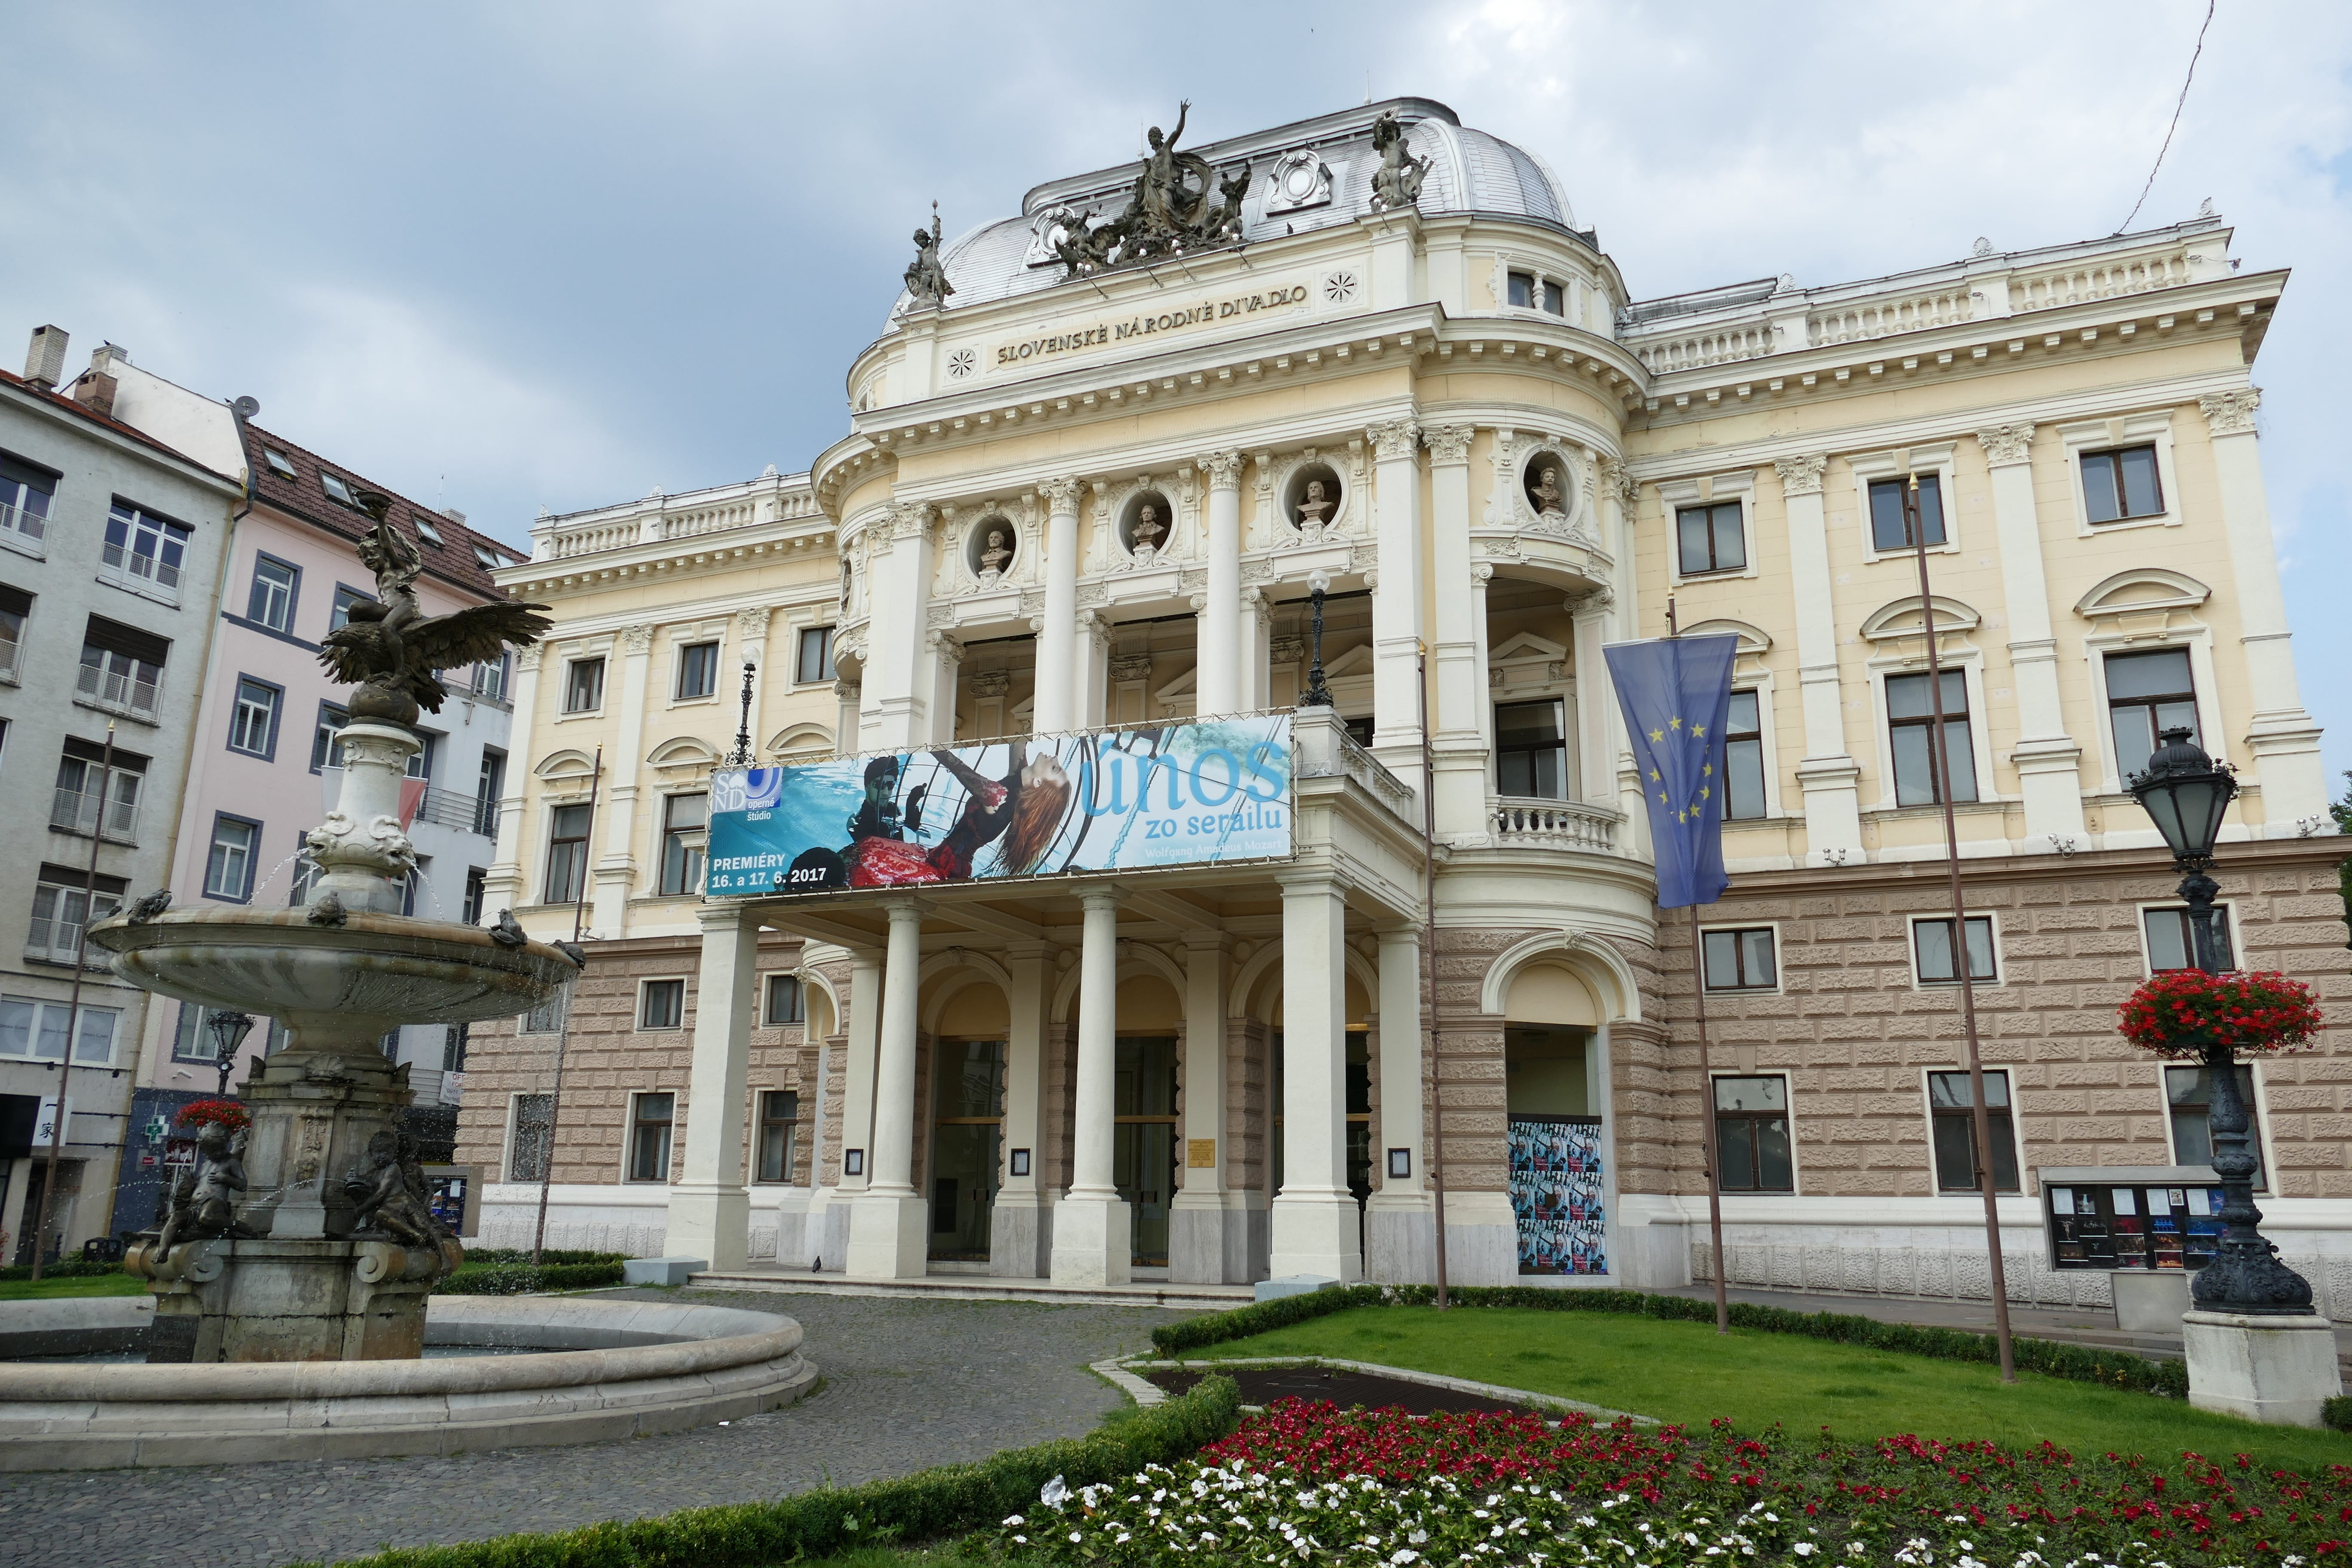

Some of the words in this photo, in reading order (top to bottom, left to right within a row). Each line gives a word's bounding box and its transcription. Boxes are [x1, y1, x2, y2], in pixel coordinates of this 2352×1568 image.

[997, 323, 1108, 364] SLOVENSKÉ
[1115, 303, 1213, 340] NÁRODNÉ
[1219, 285, 1307, 318] DIVADLO
[1081, 739, 1283, 816] únos
[748, 797, 774, 809] operné
[747, 810, 771, 821] štúdio
[1145, 818, 1177, 839] zo
[1188, 802, 1282, 835] serailu
[1145, 846, 1192, 859] Wolfgang
[1196, 842, 1241, 854] Amadeus
[1245, 839, 1282, 851] Mozart
[714, 852, 786, 871] PREMIÉRY
[712, 874, 732, 888] 16.
[737, 878, 744, 886] a
[750, 873, 769, 885] 17.
[774, 871, 786, 884] 6.
[791, 867, 827, 883] 2017
